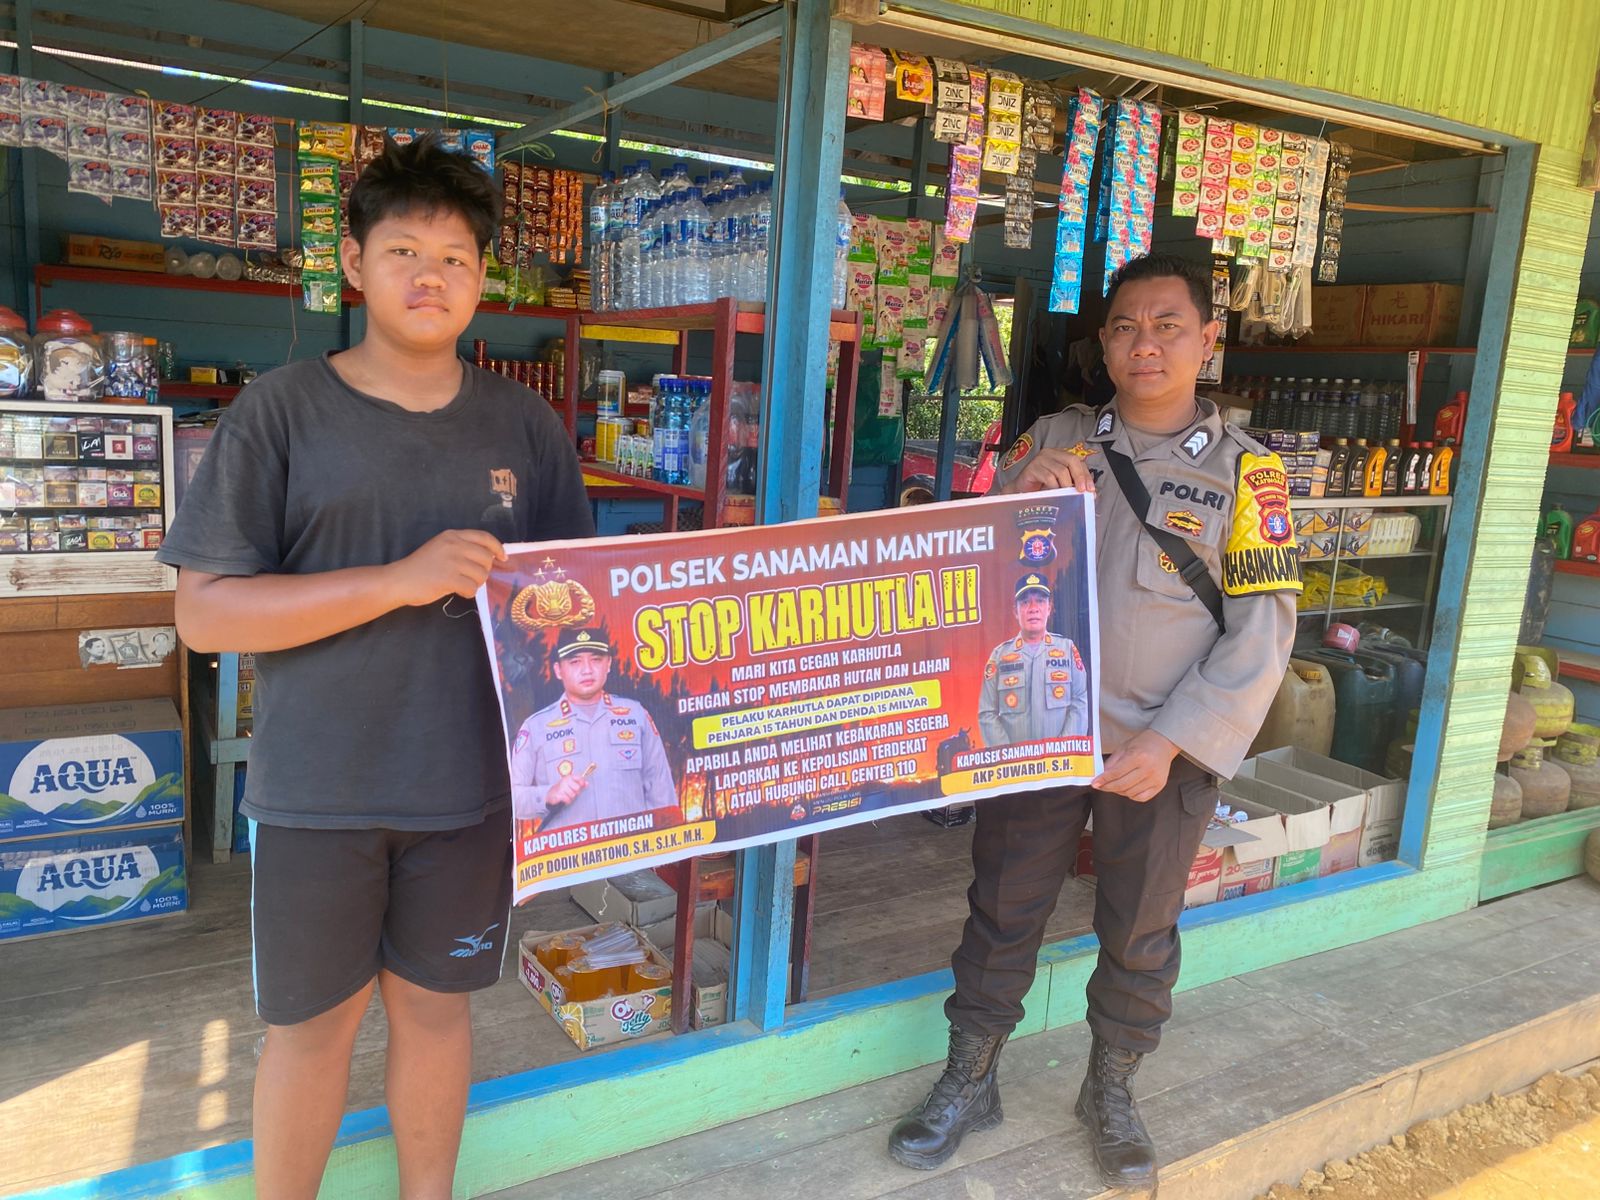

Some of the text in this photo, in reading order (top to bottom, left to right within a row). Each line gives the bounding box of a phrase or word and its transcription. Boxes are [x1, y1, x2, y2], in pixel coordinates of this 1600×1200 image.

[945, 87, 964, 99] ZINC
[998, 96, 1017, 107] ZINC
[942, 118, 961, 130] ZINC
[996, 126, 1015, 138] ZINC
[992, 155, 1011, 167] ZINC
[1370, 313, 1426, 326] HIKARI
[1160, 481, 1226, 511] POLRI
[610, 526, 995, 598] POLSEK SANAMAN MANTIKEI
[635, 567, 979, 671] STOP KARHUTLA !!!
[732, 643, 902, 683] MARI KITA CEGAH KARHUTLA
[1046, 658, 1071, 668] POLRI
[678, 657, 950, 713] DENGAN STOP MEMBAKAR HUTAN DAN LAHAN
[722, 686, 914, 728] PELAKU KARHUTLA DAPAT DIPIDANA
[610, 718, 637, 726] POLRI
[708, 697, 928, 744] PENJARA 15 TAHUN DAN DENDA 15 MILYAR
[546, 727, 575, 741] DODIK
[686, 714, 950, 774] APABILA ANDA MELIHAT KEBAKARAN SEGERA
[714, 737, 927, 791] LAPORKAN KE KEPOLISIAN TERDEKAT
[957, 739, 1091, 769] KAPOLSEK SANAMAN MANTIKEI
[29, 757, 137, 794] AQUA
[972, 766, 995, 785] AKP
[1051, 758, 1073, 772] S.H.
[730, 788, 762, 809] ATAU
[765, 778, 816, 802] HUBUNGI
[819, 773, 848, 791] CALL
[851, 763, 898, 784] CENTER
[897, 759, 917, 775] 110
[148, 808, 177, 816] MURNI
[812, 797, 862, 816] PRESISI
[523, 813, 654, 857] KAPOLRES KATINGAN
[519, 863, 545, 884] AKBP
[546, 854, 579, 874] DODIK
[683, 827, 705, 842] M.H.
[36, 852, 142, 893] AQUA
[1226, 864, 1241, 876] 20
[1257, 876, 1271, 892] 40
[152, 900, 182, 909] MURNI
[154, 895, 179, 903] 100%
[622, 1011, 652, 1031] Jelly
